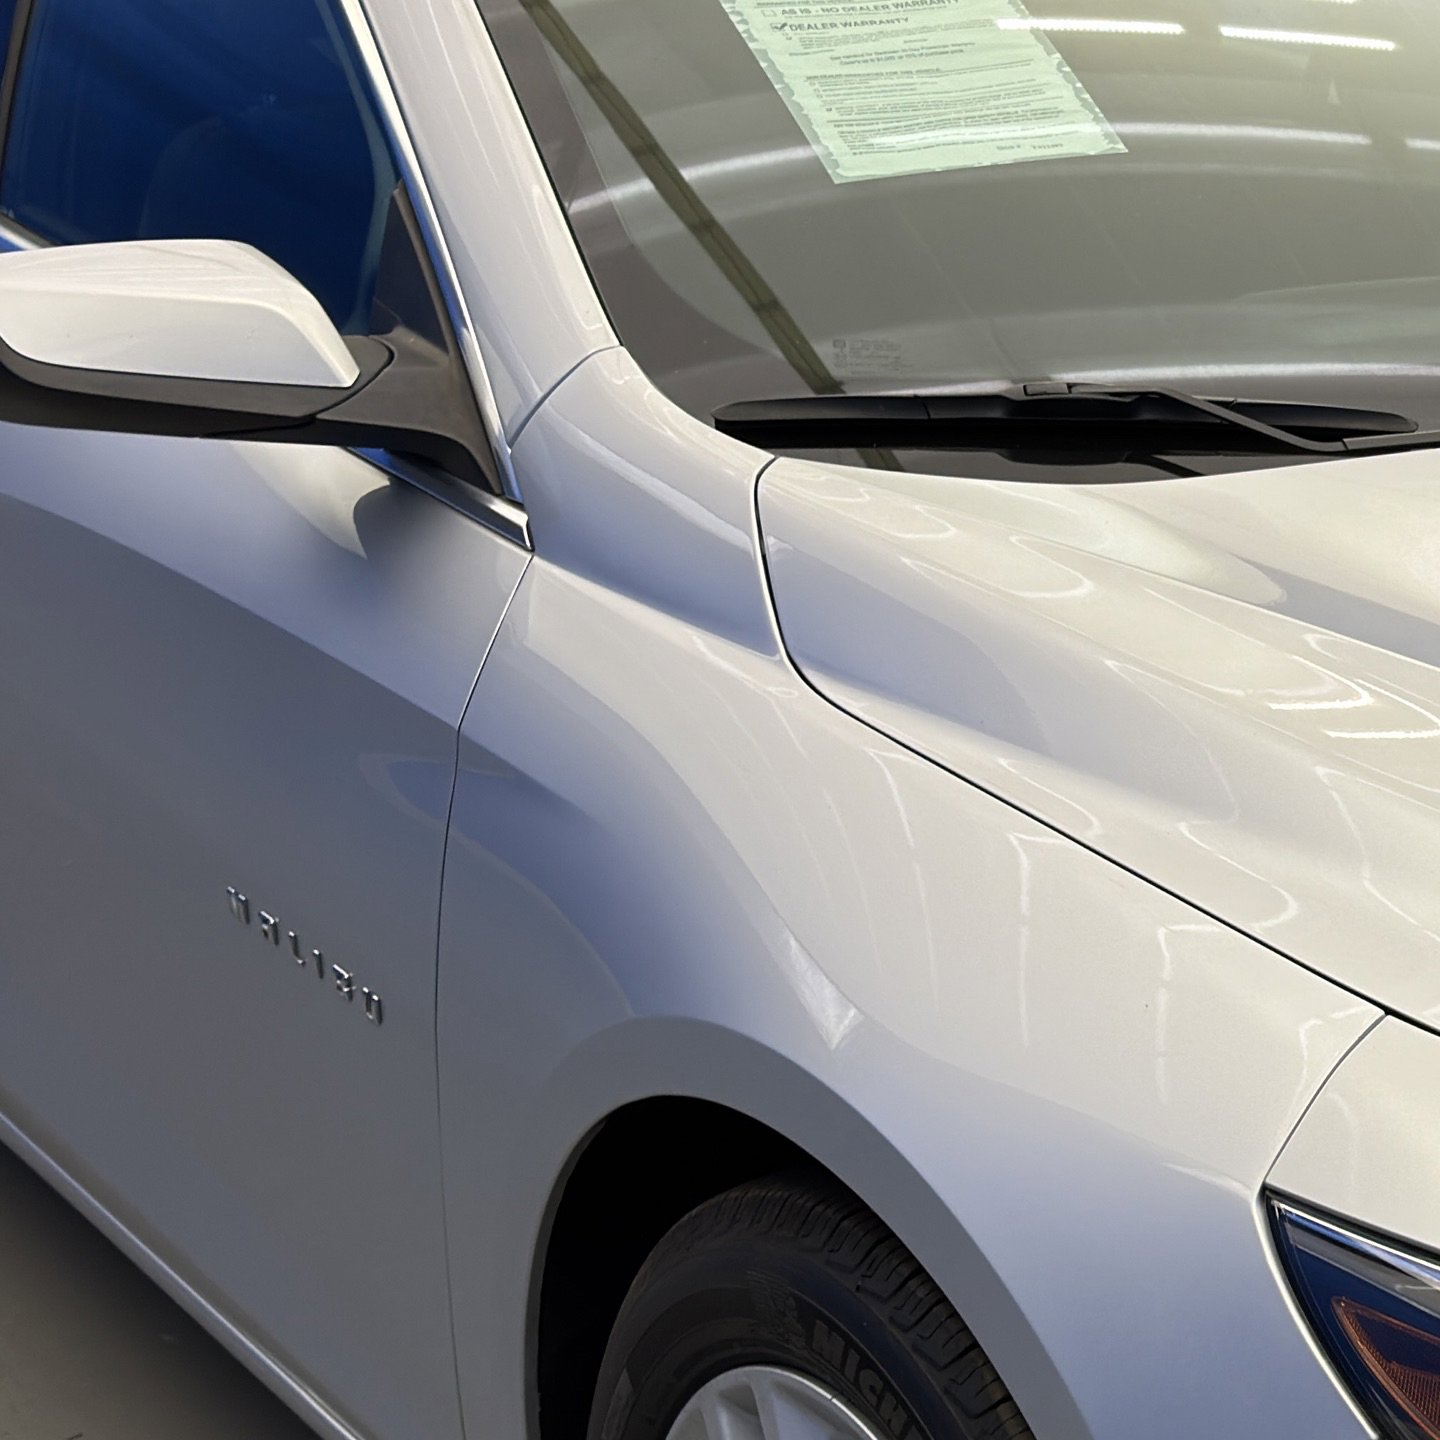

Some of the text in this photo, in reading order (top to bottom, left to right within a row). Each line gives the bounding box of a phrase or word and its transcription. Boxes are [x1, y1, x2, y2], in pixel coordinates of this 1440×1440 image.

[781, 8, 797, 16] AS
[800, 7, 812, 15] IS
[821, 6, 840, 14] NO
[842, 2, 891, 14] DEALER
[789, 17, 909, 32] DEALER WARRANTY
